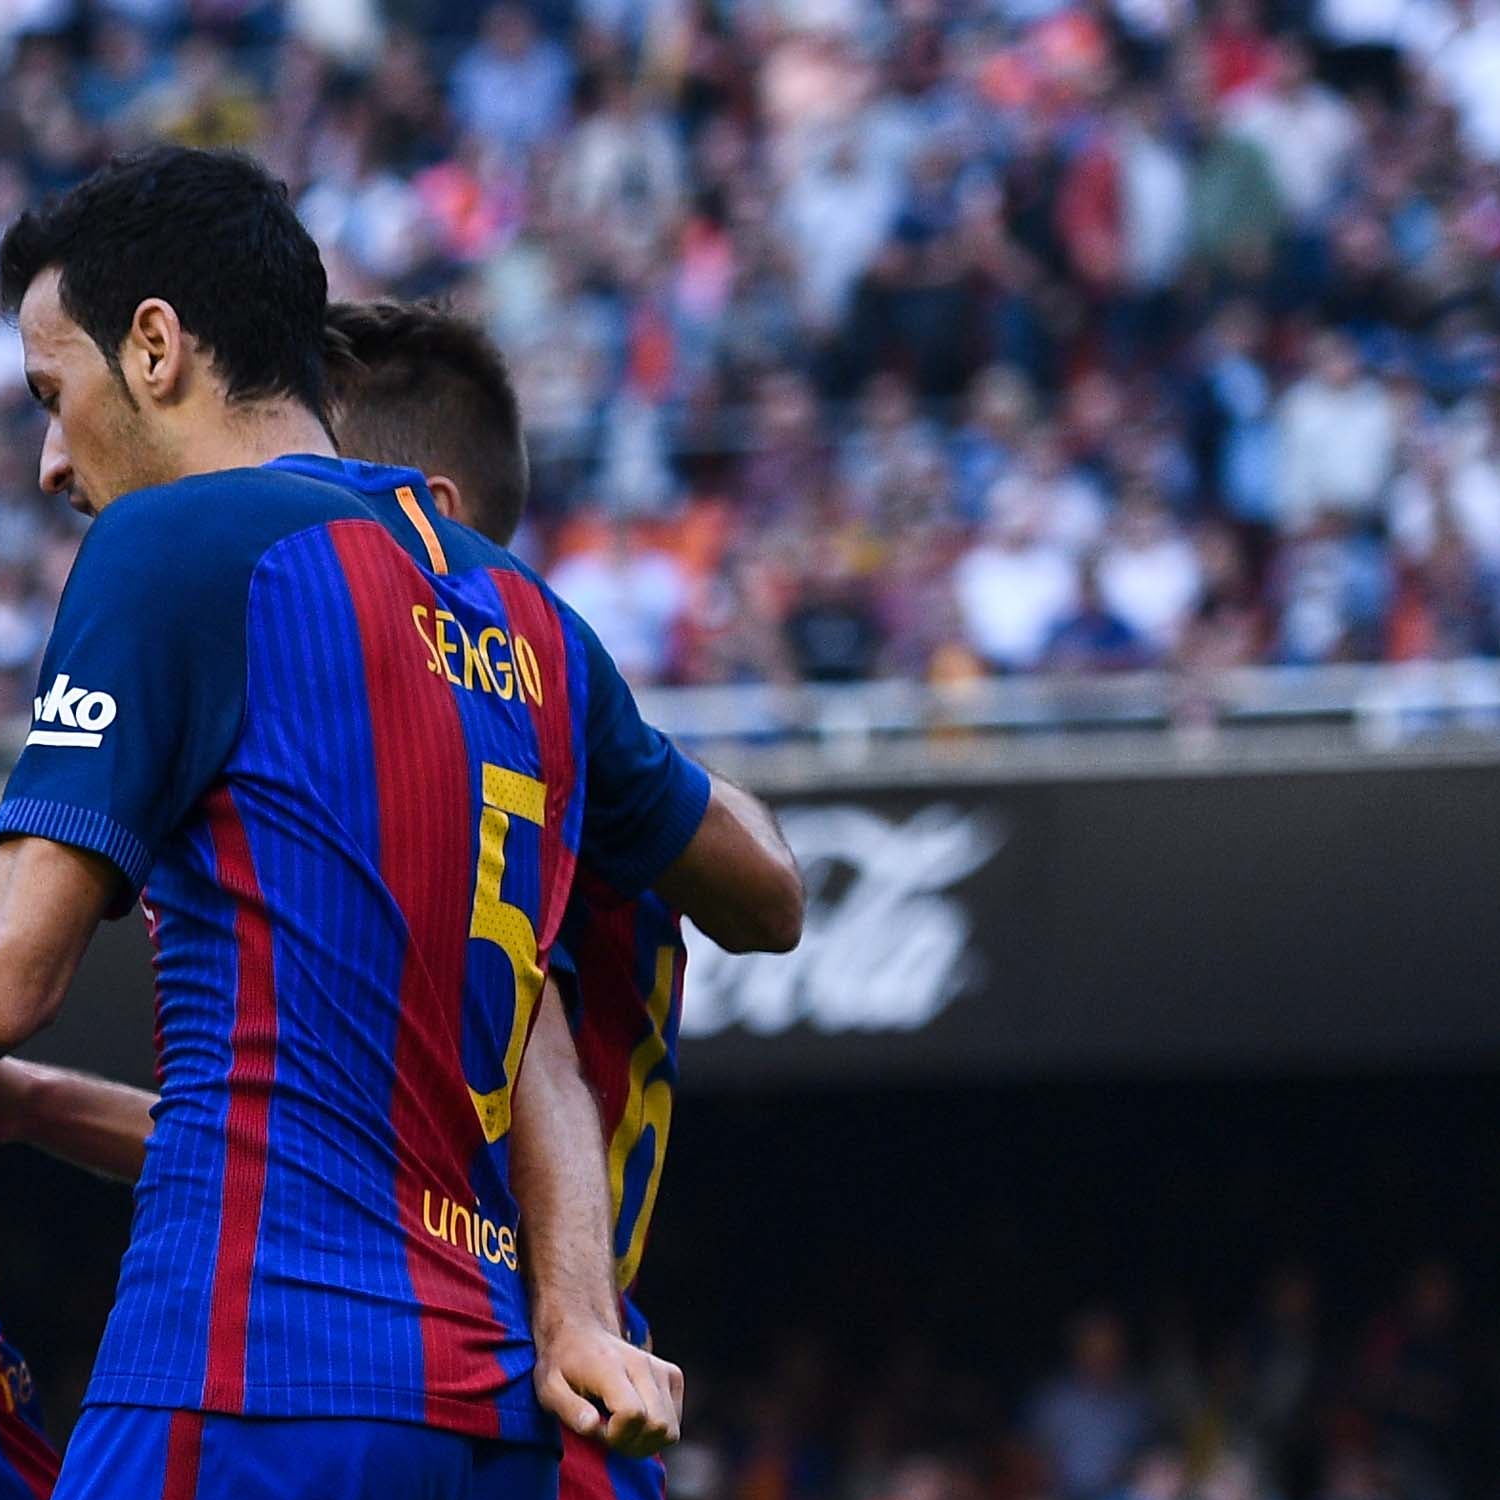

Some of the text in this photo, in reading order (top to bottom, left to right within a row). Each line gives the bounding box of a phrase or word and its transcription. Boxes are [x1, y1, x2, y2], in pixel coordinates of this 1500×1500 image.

[411, 604, 543, 708] SERGIO
[464, 762, 548, 1144] 5
[423, 1189, 519, 1272] unice
